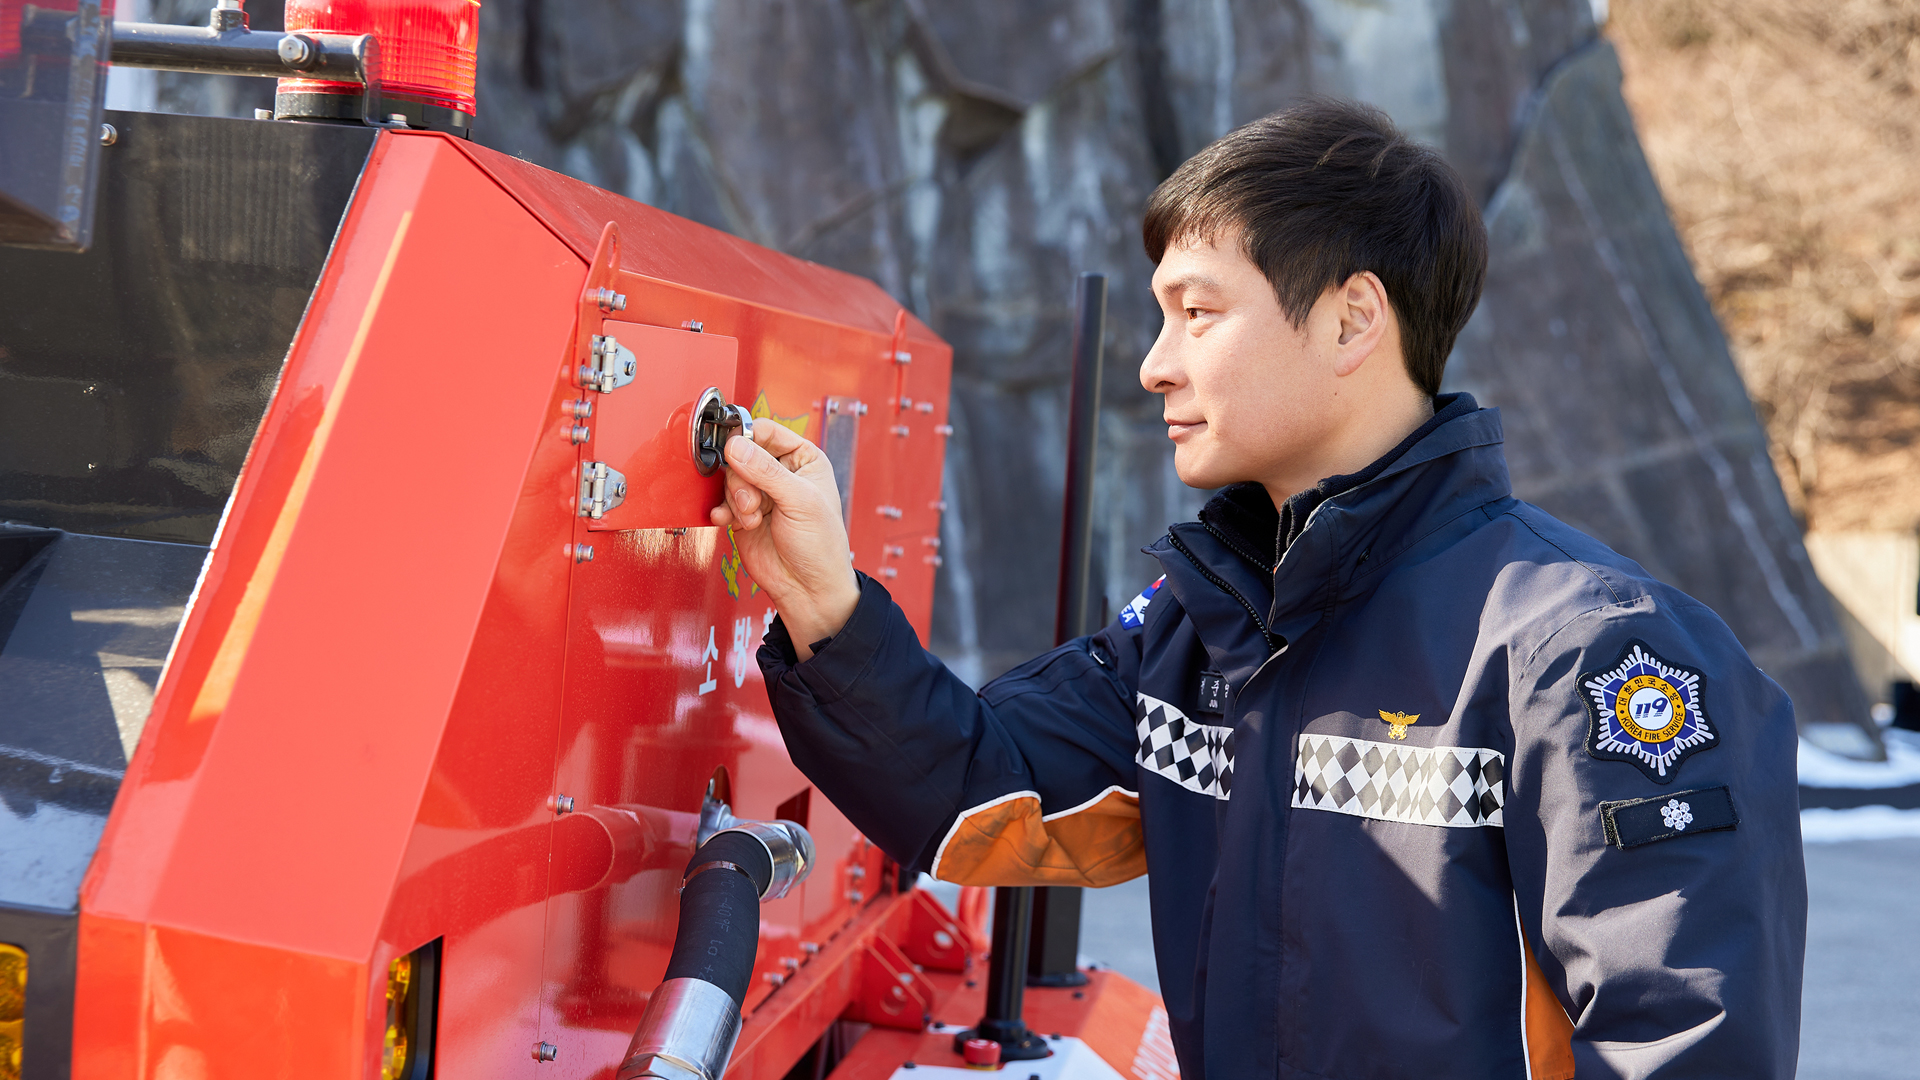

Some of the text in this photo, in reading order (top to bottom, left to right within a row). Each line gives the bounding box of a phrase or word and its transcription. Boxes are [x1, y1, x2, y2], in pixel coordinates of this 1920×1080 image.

[1618, 677, 1679, 706] 대한민국소방
[1634, 696, 1669, 719] 119
[1621, 712, 1684, 741] KOREA FIRE SERVICE
